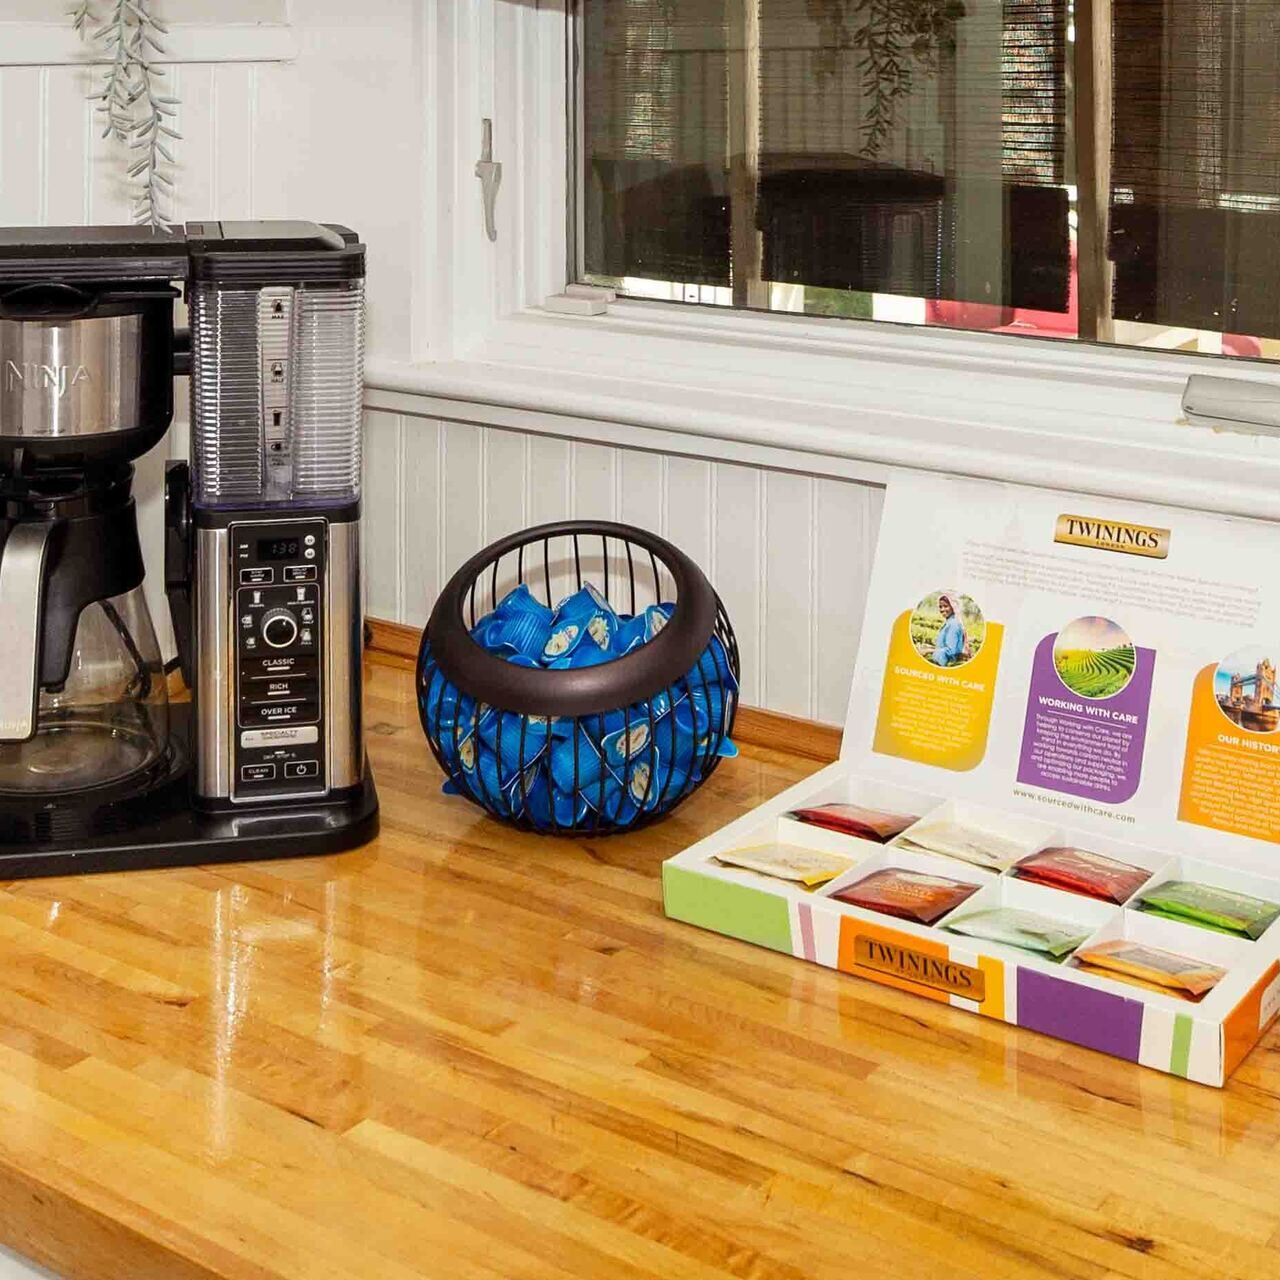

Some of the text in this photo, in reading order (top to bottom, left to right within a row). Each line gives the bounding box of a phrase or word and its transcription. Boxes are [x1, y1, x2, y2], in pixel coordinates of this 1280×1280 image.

[6, 360, 91, 398] NINJA
[1066, 519, 1160, 549] TWININGS
[262, 658, 295, 667] CLASSIC
[894, 665, 985, 693] SOURCED WITH CARE
[261, 706, 298, 716] OVER ICE
[1038, 695, 1139, 725] WORKING WITH CARE
[1217, 734, 1240, 746] OUR
[1013, 788, 1136, 824] www.sourcedwithcare.com
[865, 939, 972, 988] TWININGS
